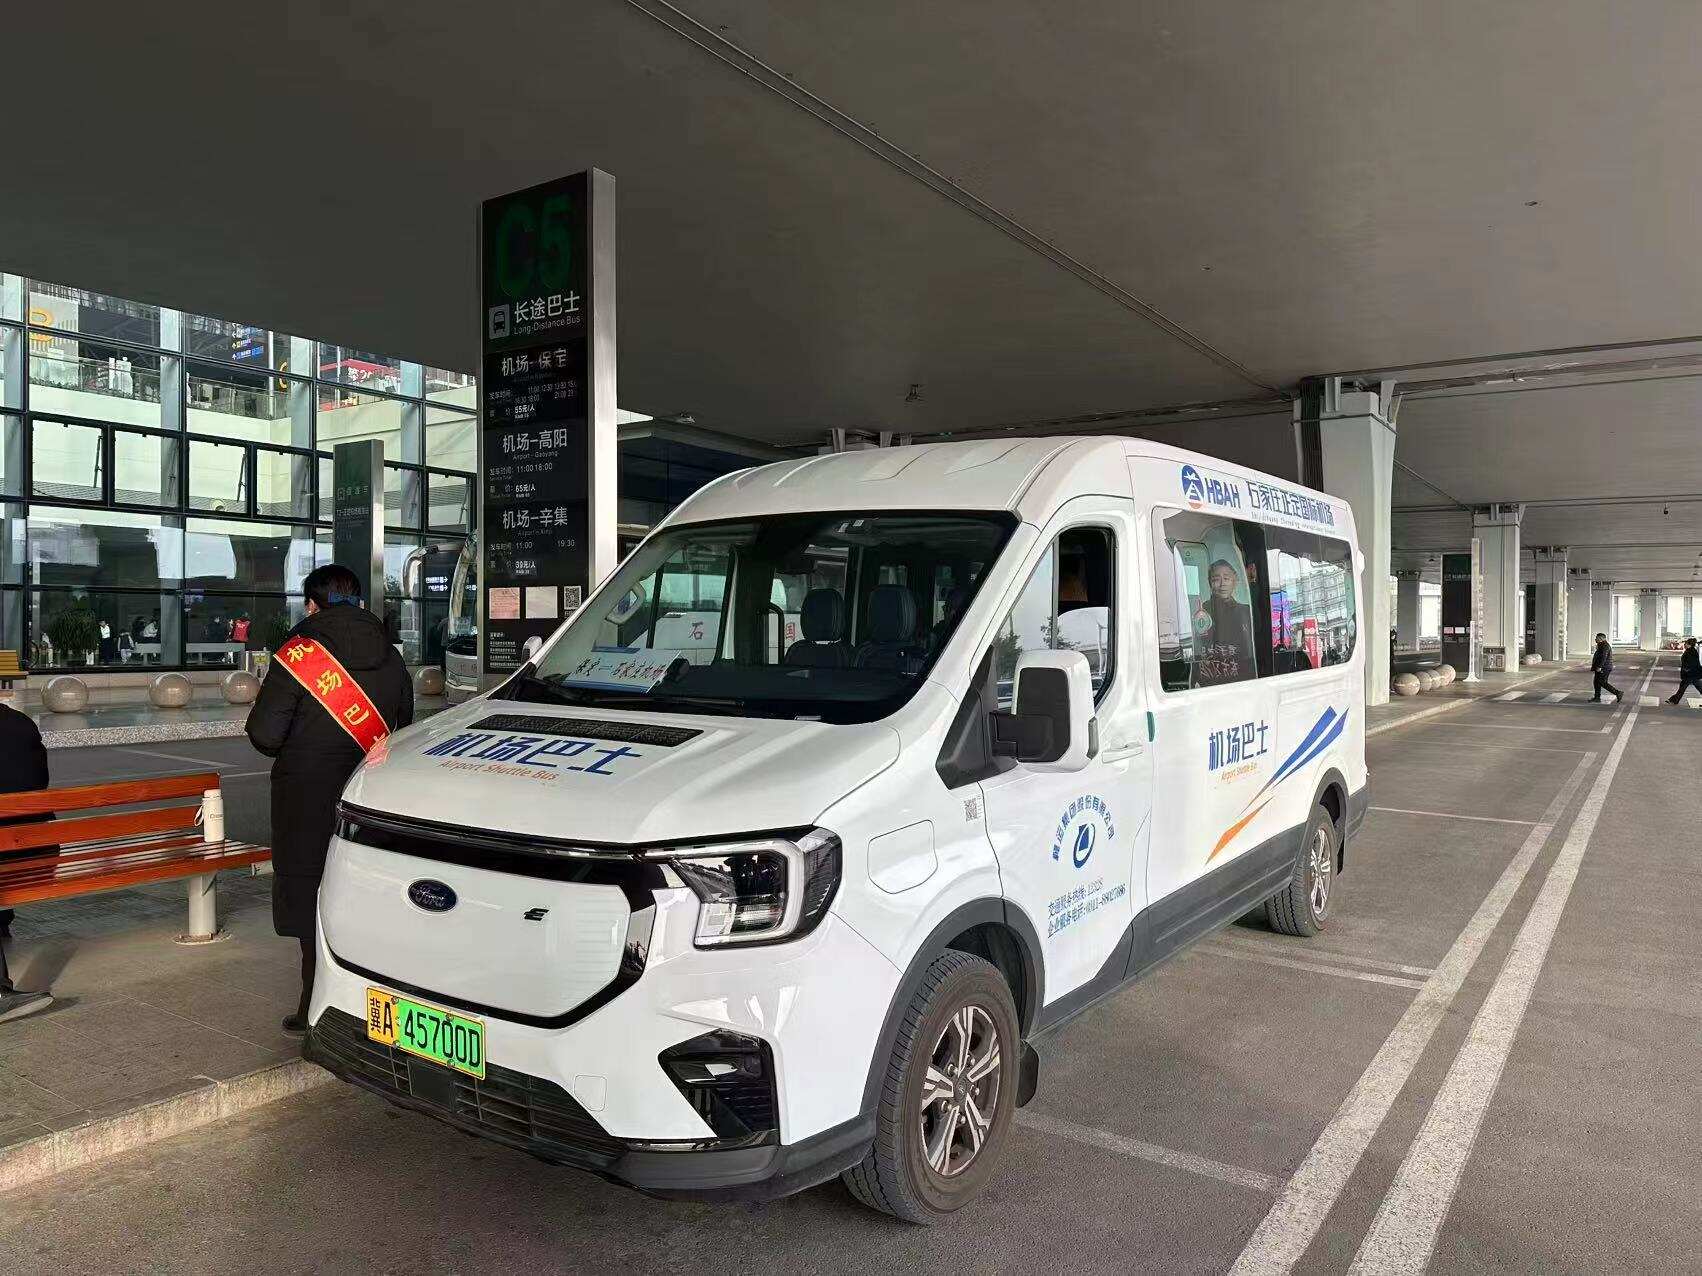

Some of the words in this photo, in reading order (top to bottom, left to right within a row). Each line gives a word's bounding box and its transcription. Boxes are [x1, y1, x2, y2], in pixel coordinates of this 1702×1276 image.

[513, 290, 581, 324] 长途巴士
[566, 315, 581, 325] Bus
[1205, 477, 1241, 509] HBAH
[422, 733, 642, 776] 机场巴士
[1208, 720, 1269, 771] 机场巴士
[440, 760, 484, 772] Airport
[483, 764, 532, 777] Shuttle
[532, 770, 560, 780] Bus
[404, 1008, 481, 1068] 45700D
